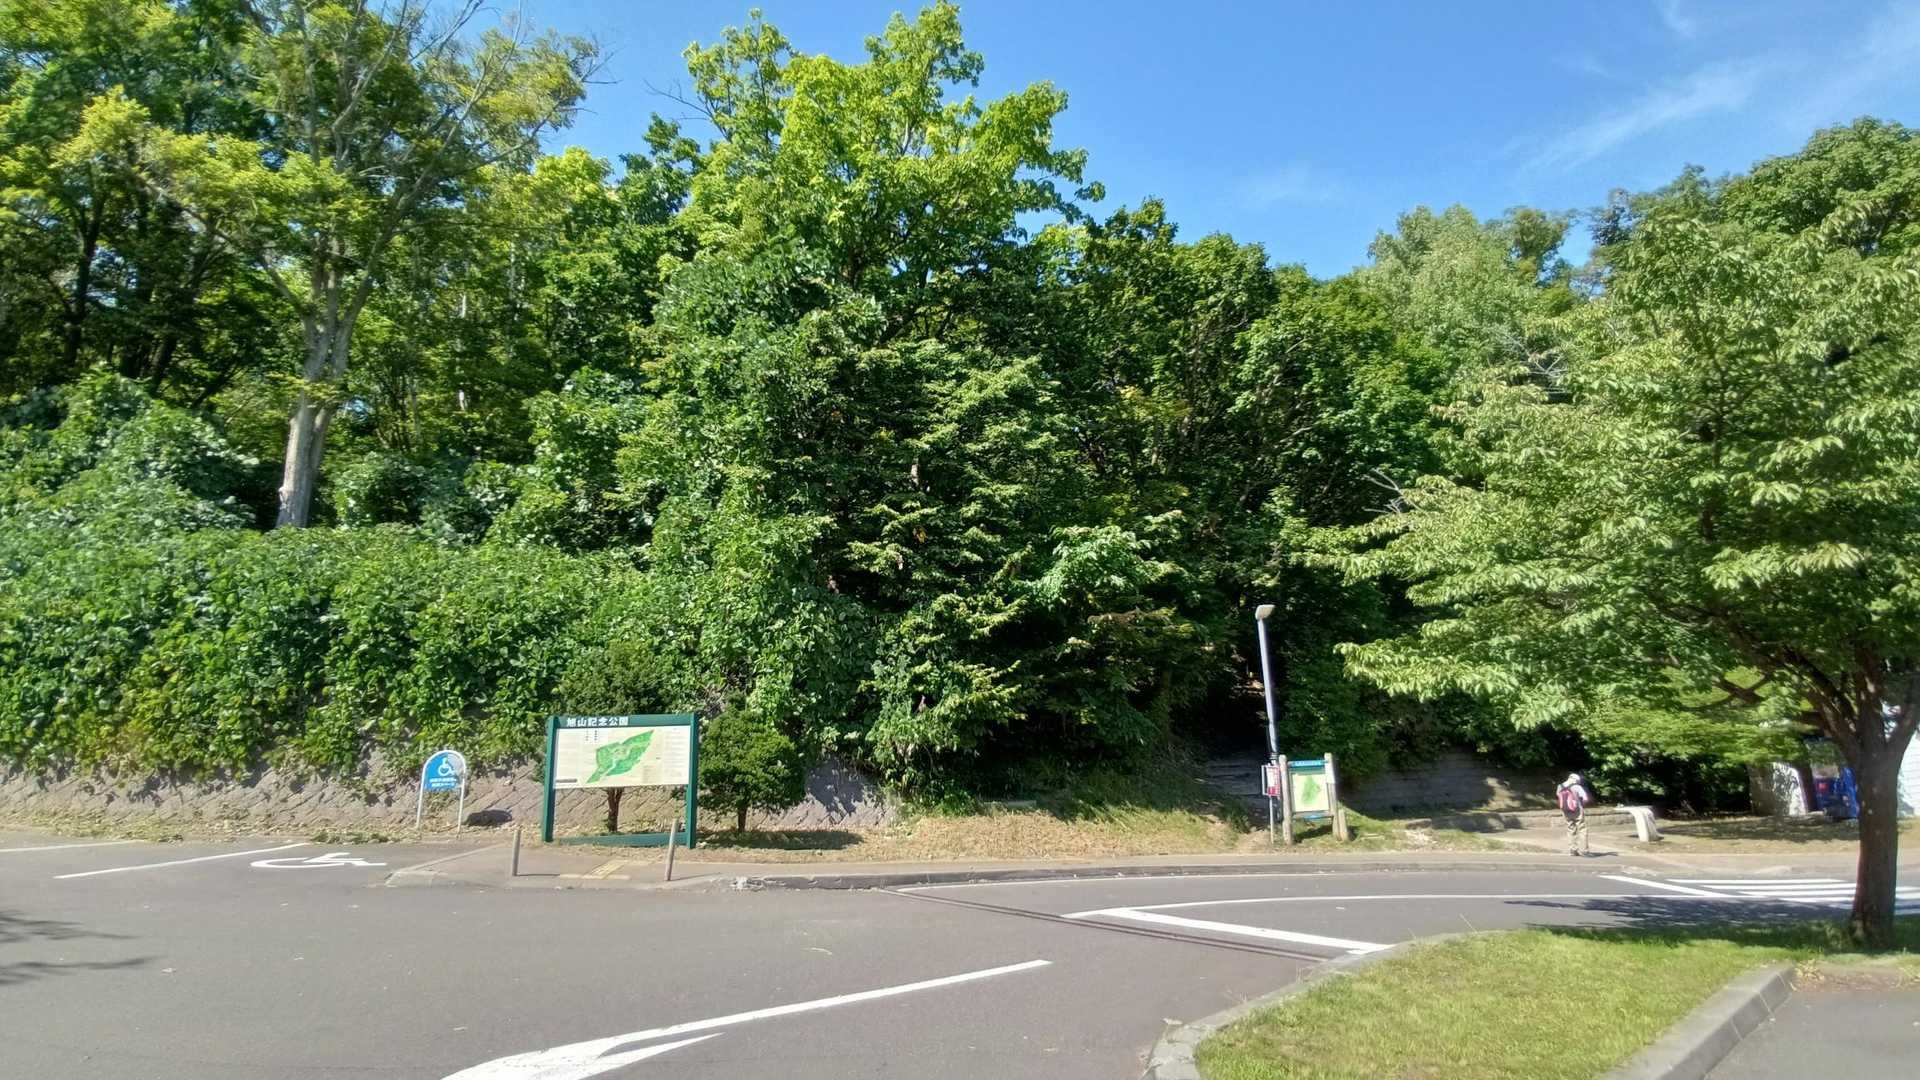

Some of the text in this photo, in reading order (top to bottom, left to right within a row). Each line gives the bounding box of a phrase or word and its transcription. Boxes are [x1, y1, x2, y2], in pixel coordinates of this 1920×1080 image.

[566, 716, 629, 727] 旭山記念公園
